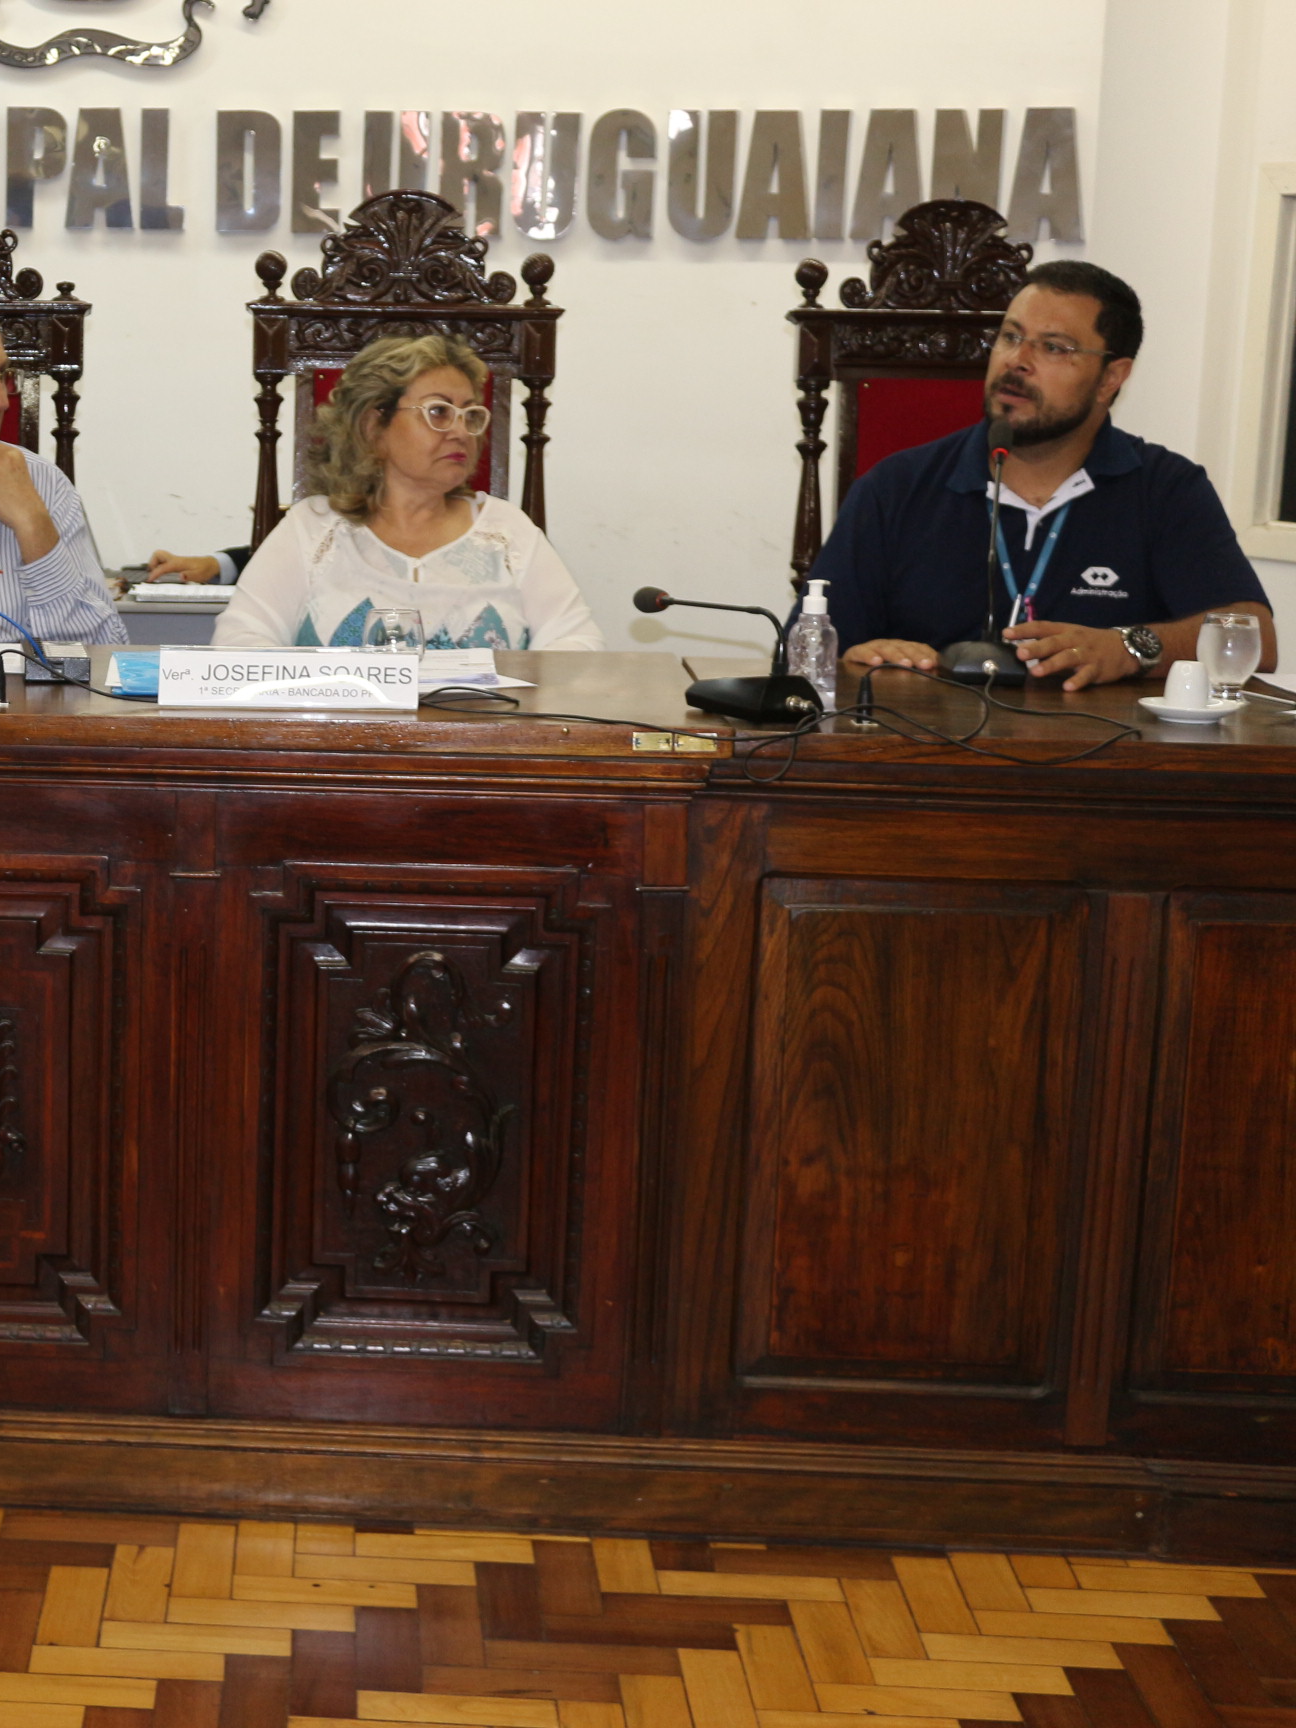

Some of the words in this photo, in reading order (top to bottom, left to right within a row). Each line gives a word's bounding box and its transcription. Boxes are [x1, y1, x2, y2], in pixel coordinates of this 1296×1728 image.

[215, 109, 342, 234] DE
[362, 106, 1086, 241] URUGUAIANA
[200, 664, 312, 682] JOSEFINA
[318, 665, 413, 685] SOARES
[288, 687, 340, 697] BANCADA
[342, 688, 359, 698] DO
